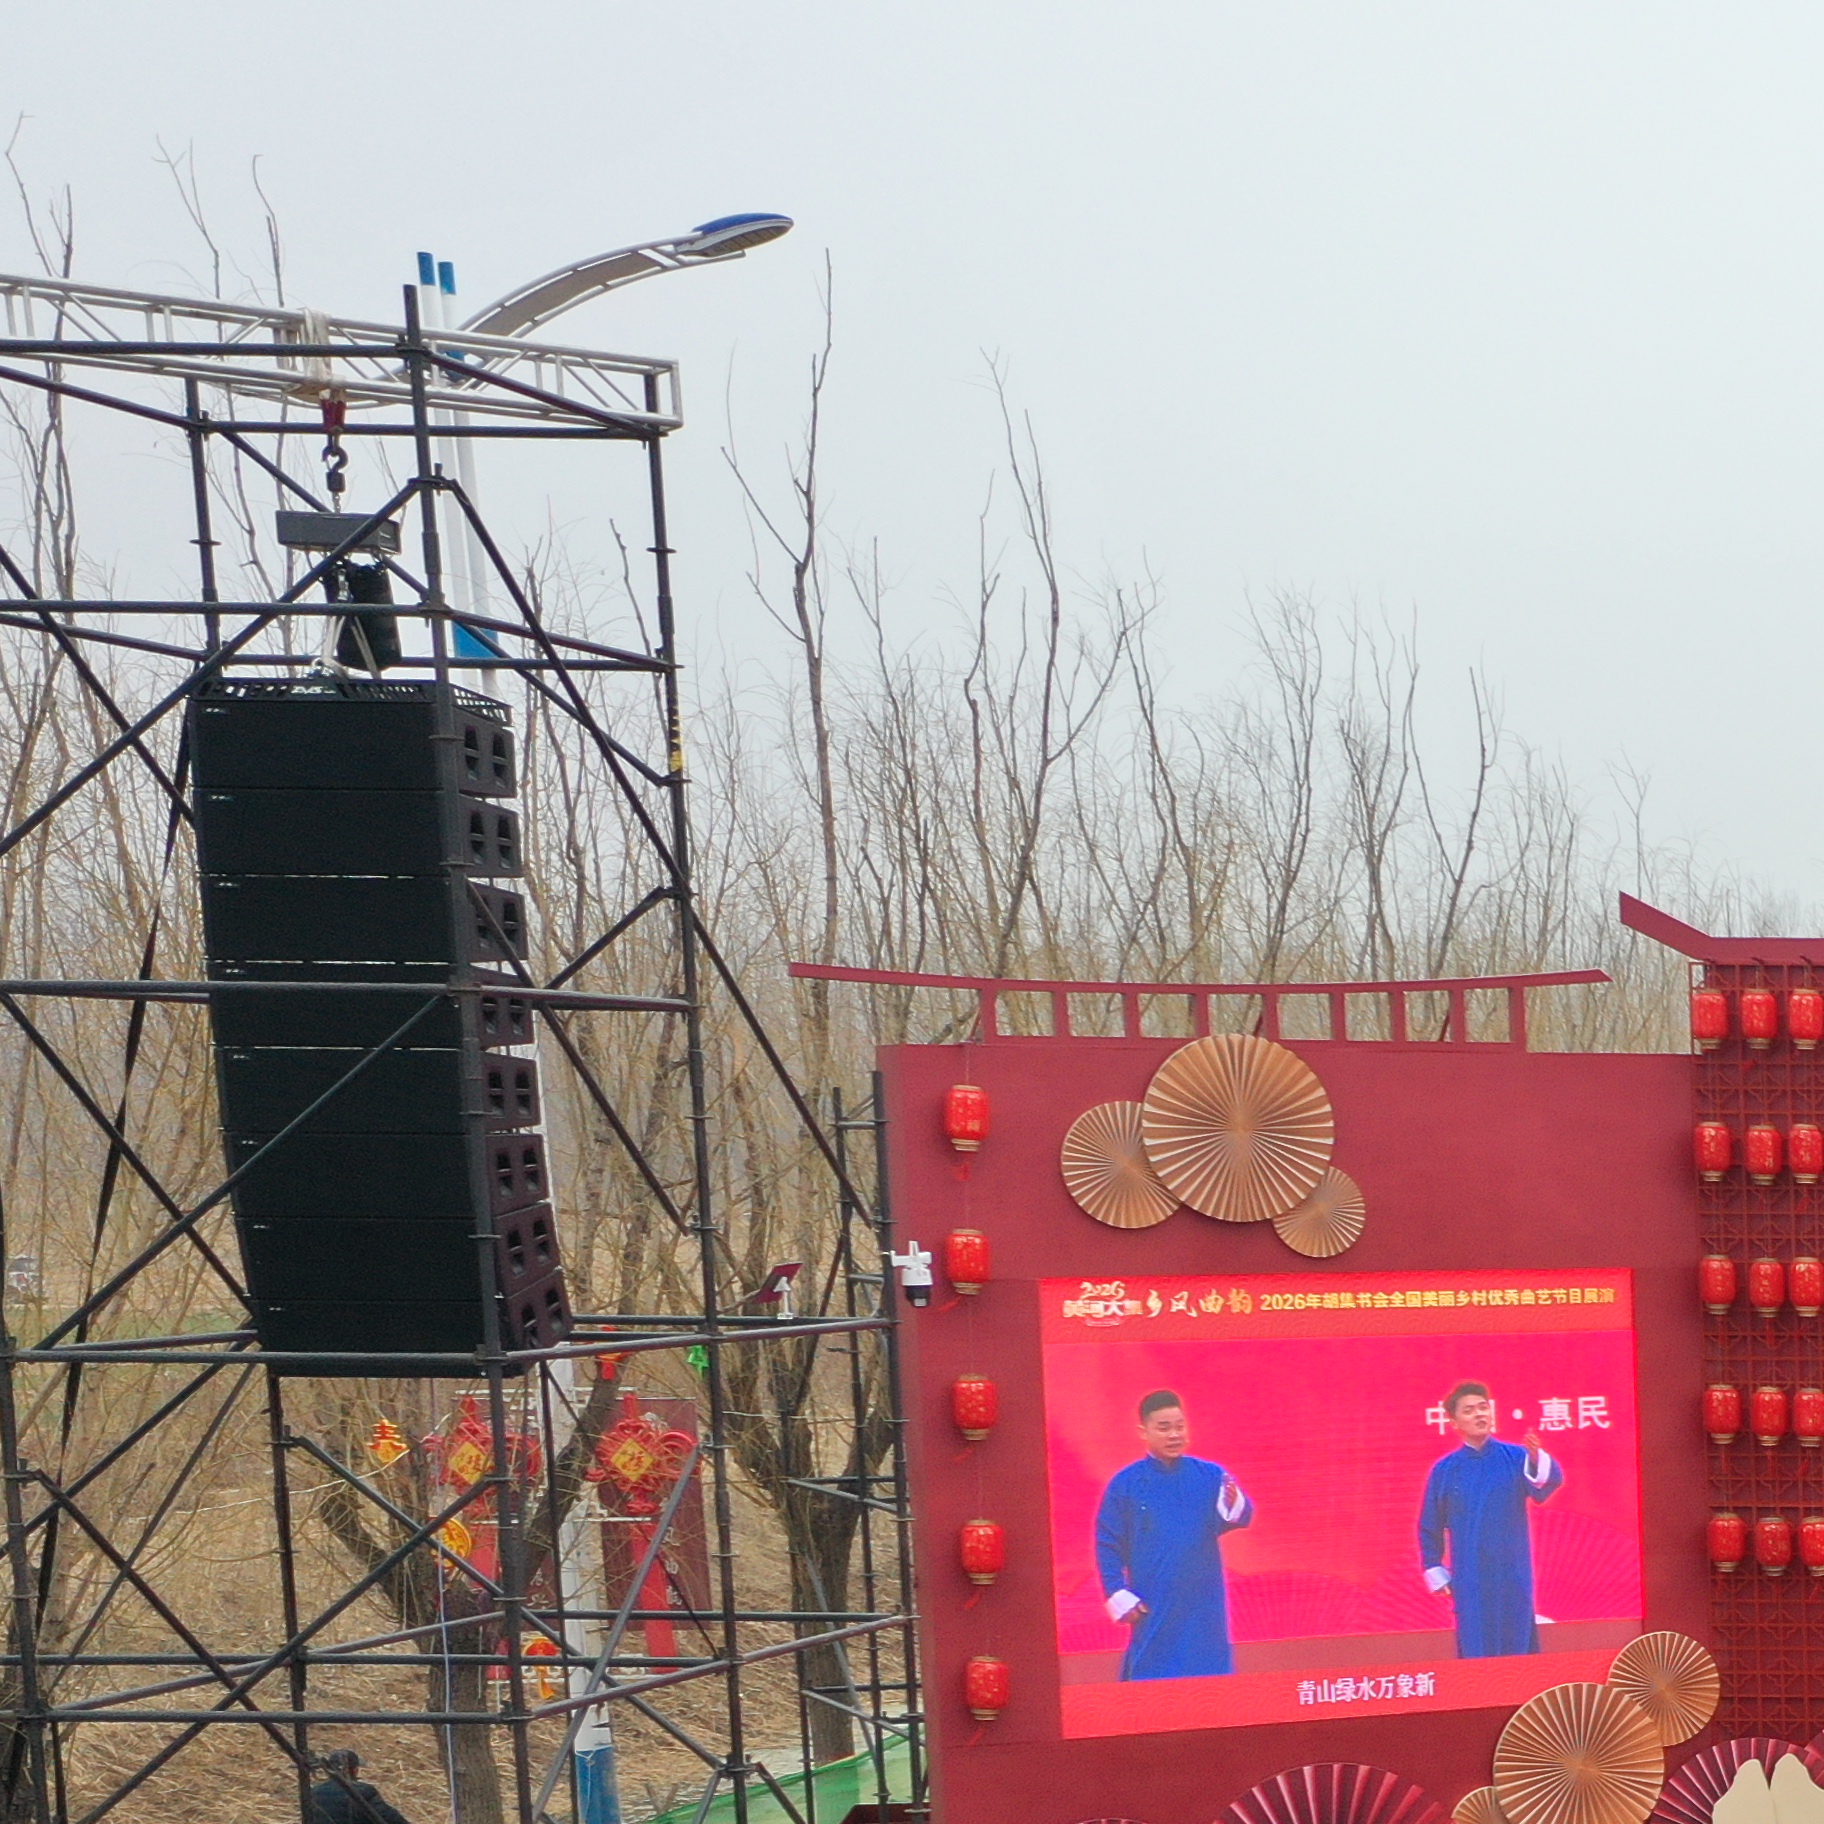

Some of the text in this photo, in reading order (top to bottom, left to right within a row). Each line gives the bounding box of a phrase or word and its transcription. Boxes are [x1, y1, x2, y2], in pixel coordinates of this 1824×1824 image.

[1425, 1396, 1610, 1435] 中·惠民
[1296, 1672, 1435, 1706] 青山绿水万象新
